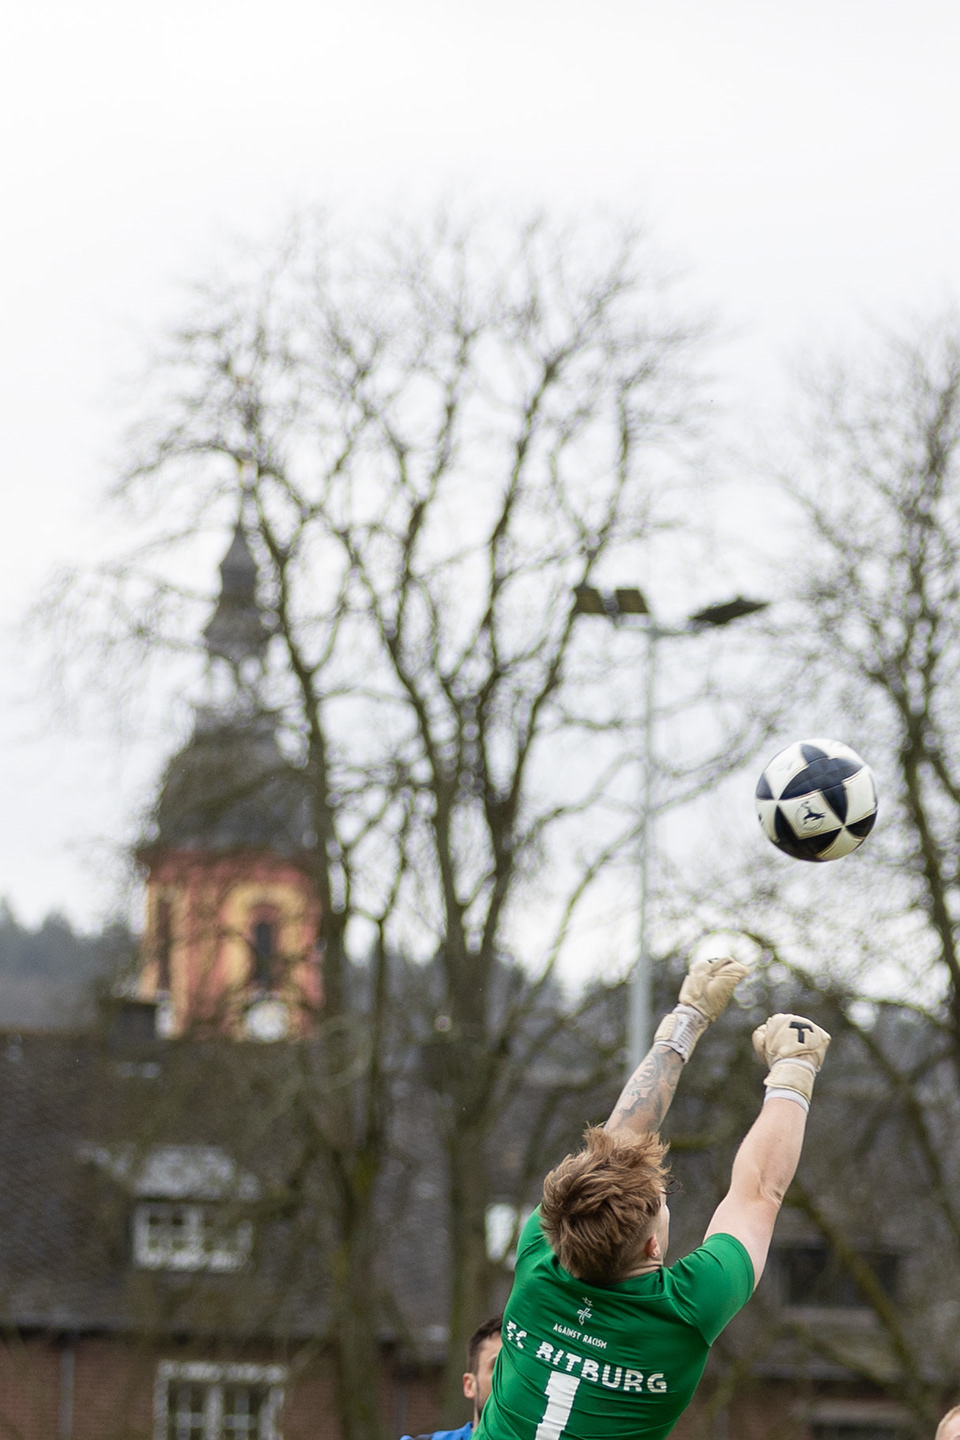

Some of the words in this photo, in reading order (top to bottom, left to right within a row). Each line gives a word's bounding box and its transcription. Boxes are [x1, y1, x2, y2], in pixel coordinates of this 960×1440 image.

[553, 1323, 582, 1341] AGAINST
[582, 1335, 608, 1349] RACISM
[536, 1341, 667, 1393] BITBURG
